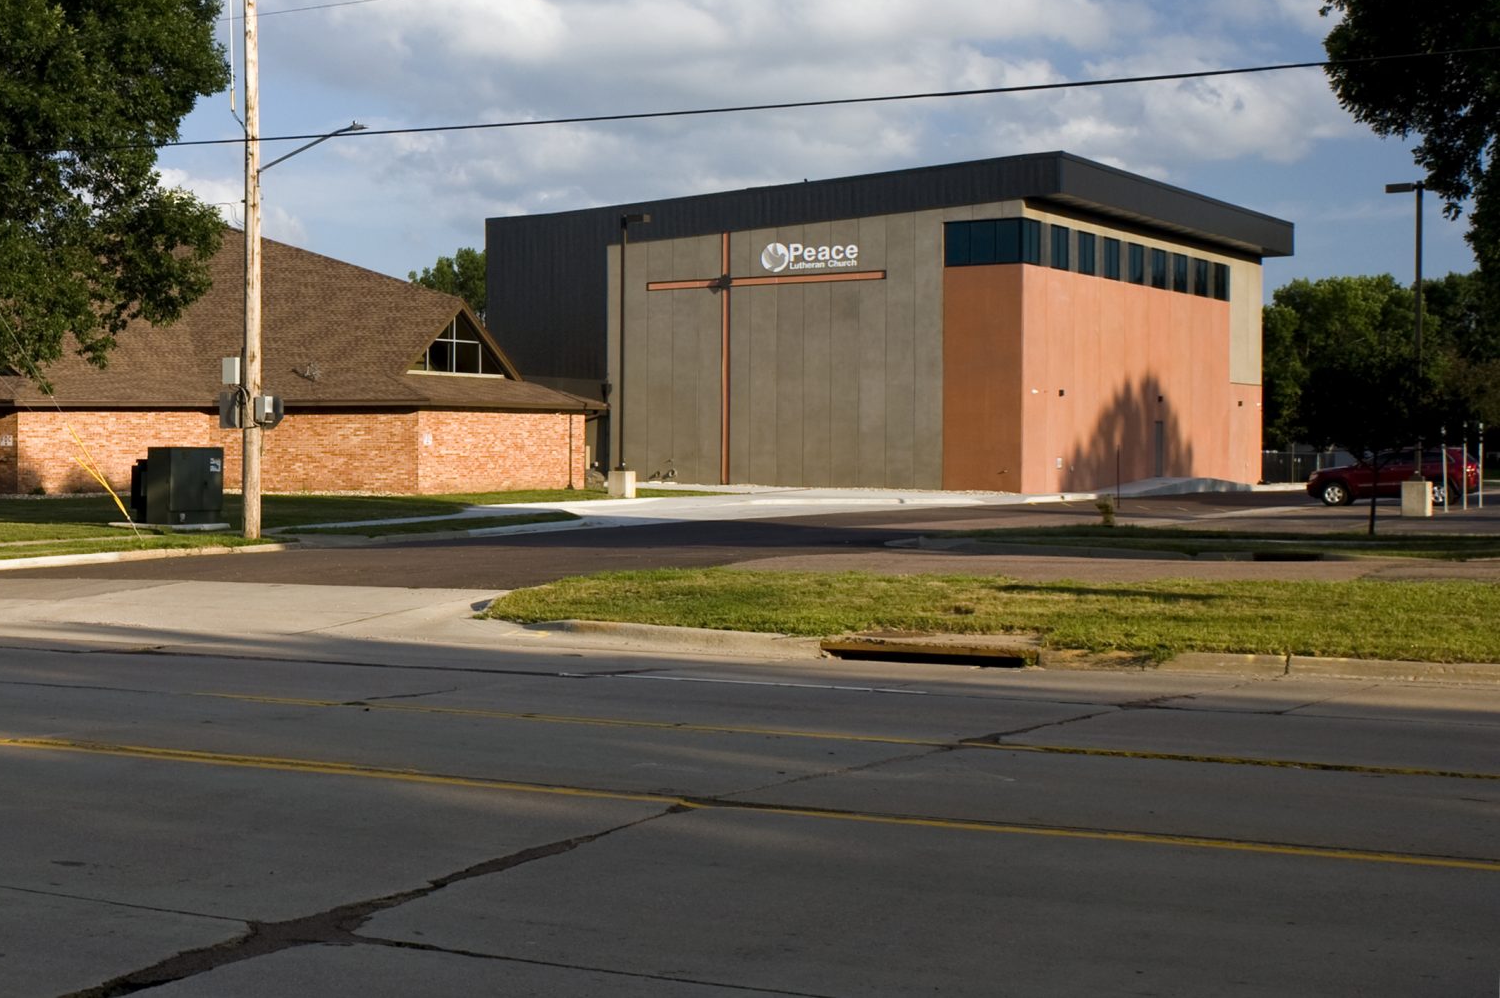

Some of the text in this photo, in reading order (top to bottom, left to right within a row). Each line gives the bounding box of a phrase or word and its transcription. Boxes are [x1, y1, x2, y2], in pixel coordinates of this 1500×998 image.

[789, 243, 858, 261] Peace
[789, 259, 857, 270] Lutheran Church
